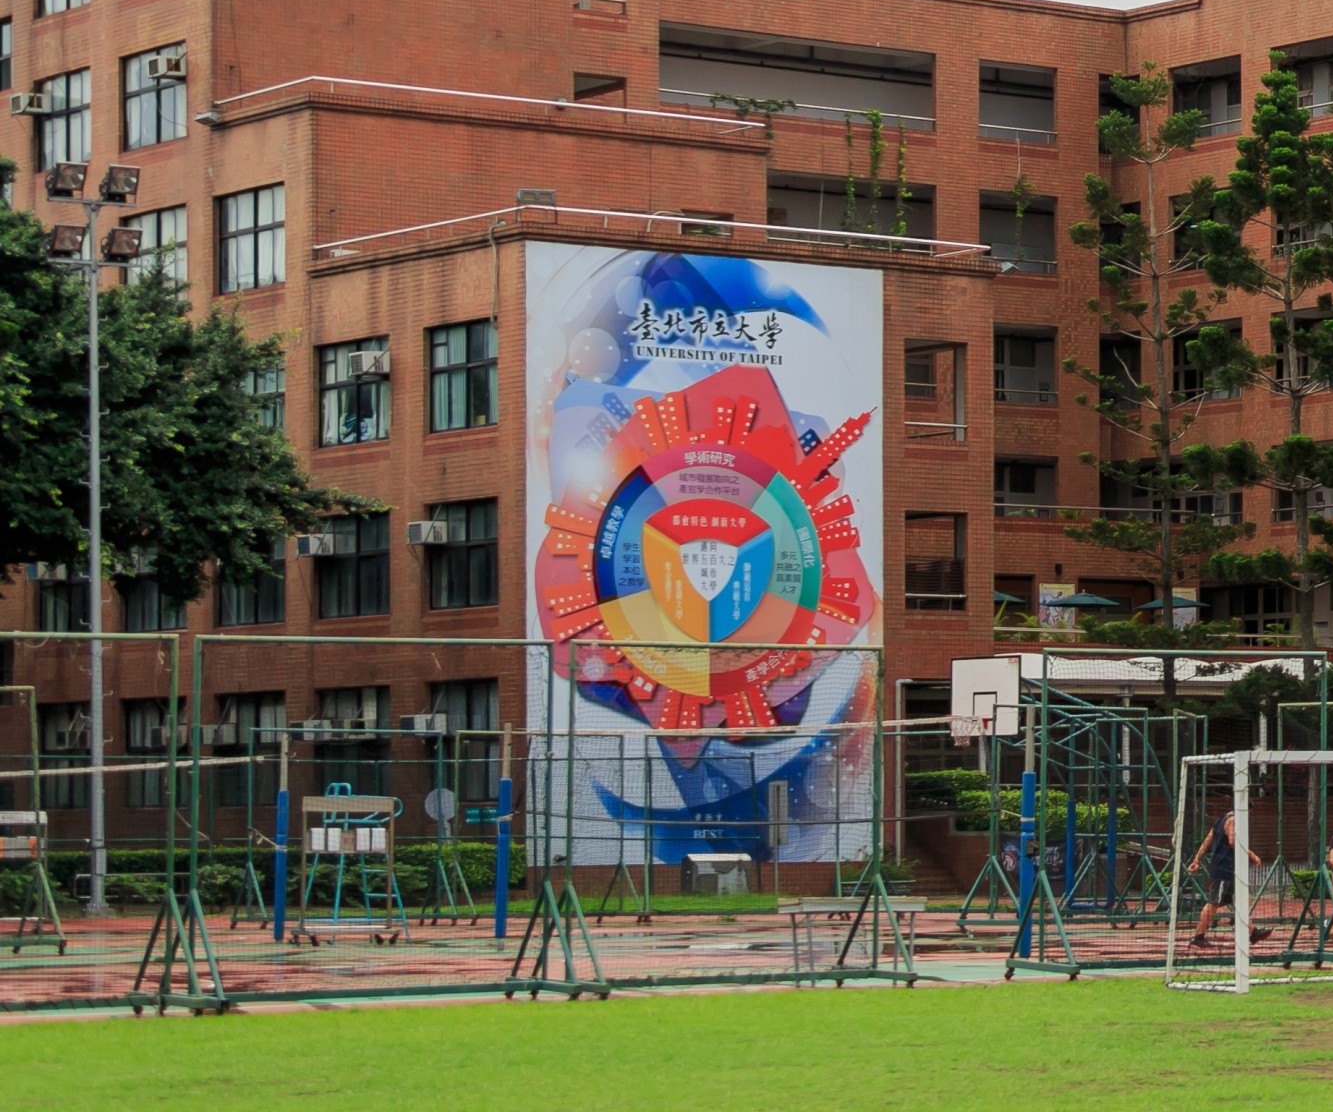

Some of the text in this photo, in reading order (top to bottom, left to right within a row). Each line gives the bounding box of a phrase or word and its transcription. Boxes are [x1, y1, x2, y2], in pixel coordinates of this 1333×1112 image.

[631, 301, 783, 350] 臺北市立大學
[635, 345, 783, 366] UNIVERSITY OF TAIPEI
[684, 450, 736, 467] 學術研究
[600, 504, 625, 560] 卓越教學
